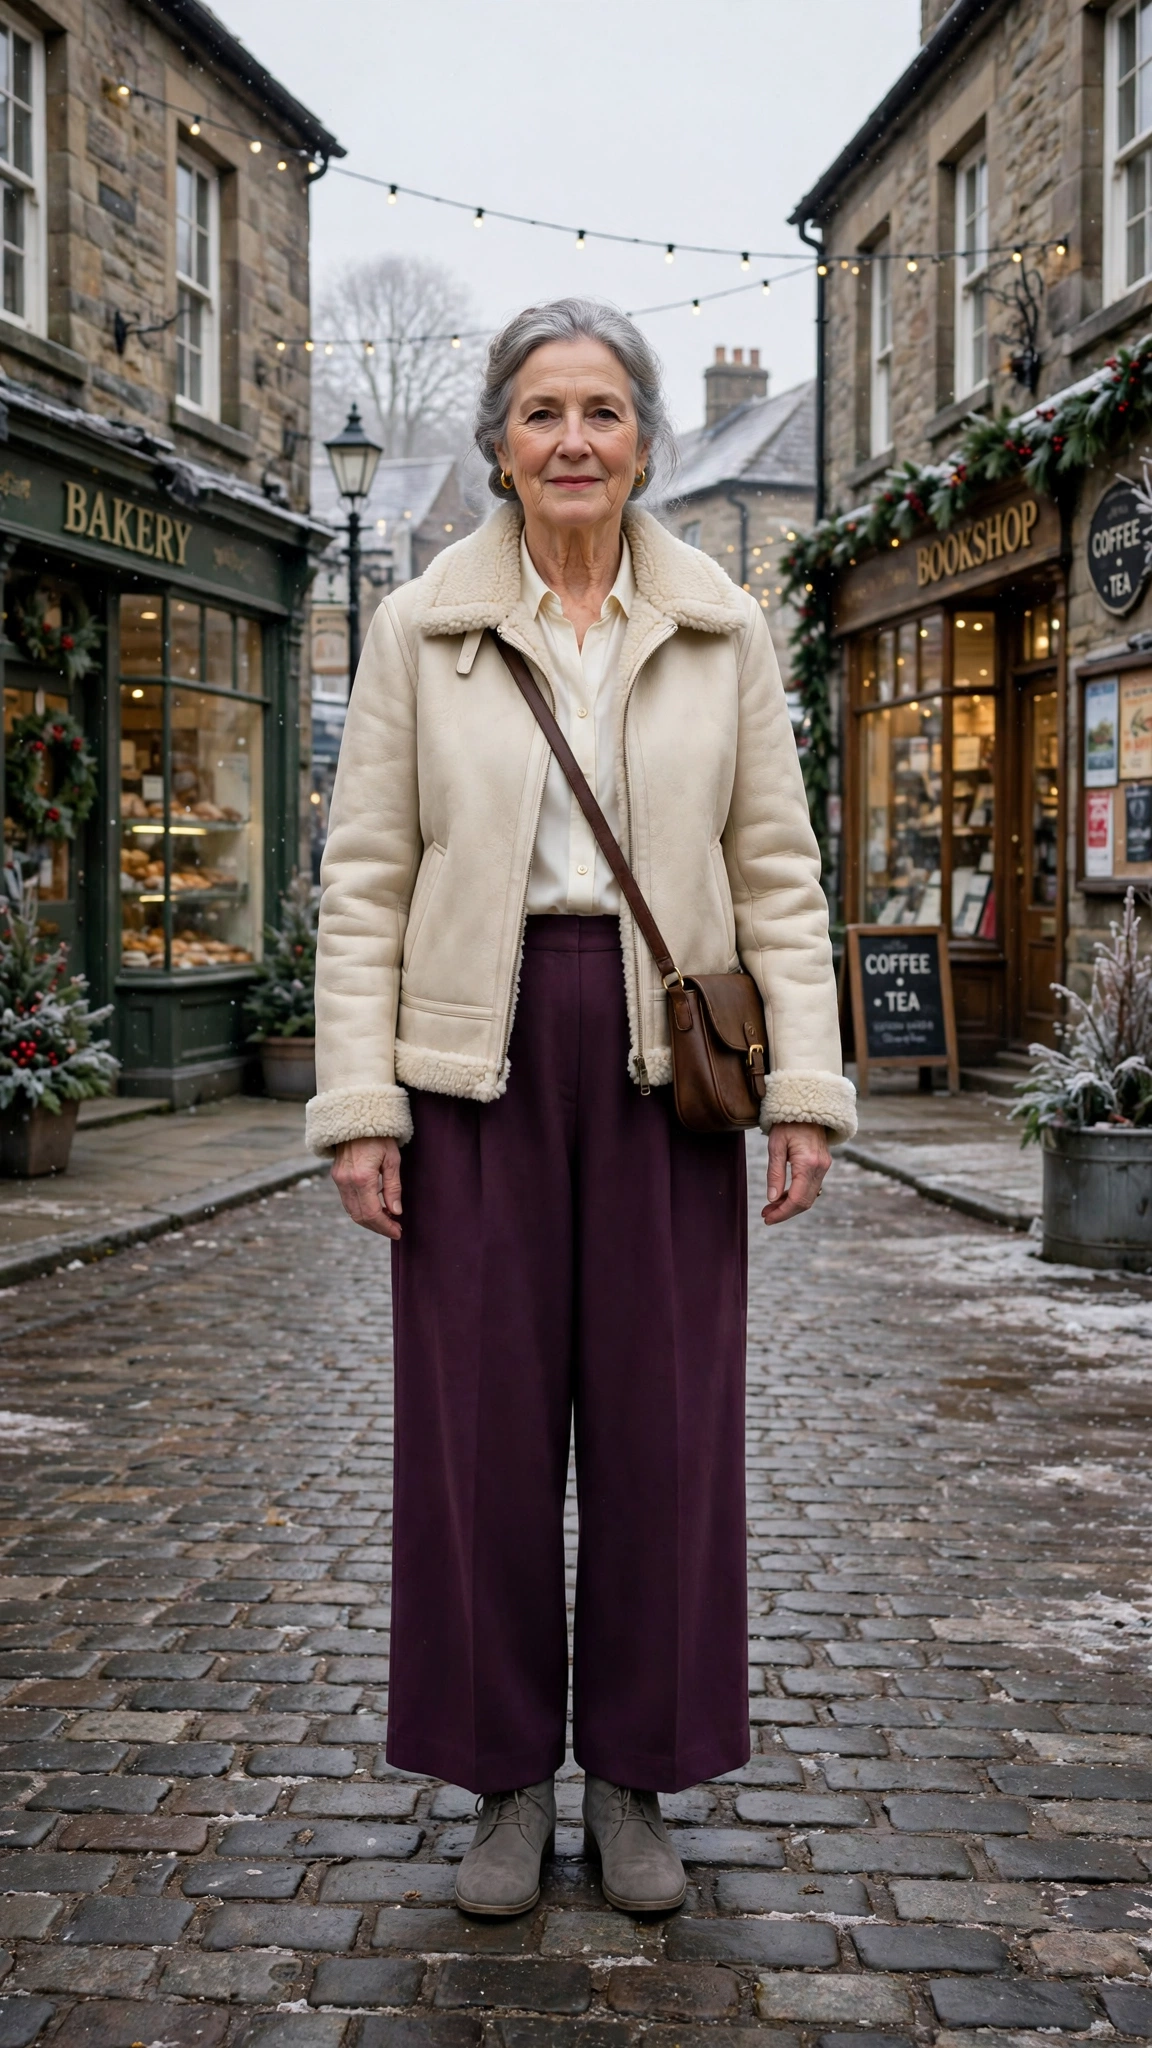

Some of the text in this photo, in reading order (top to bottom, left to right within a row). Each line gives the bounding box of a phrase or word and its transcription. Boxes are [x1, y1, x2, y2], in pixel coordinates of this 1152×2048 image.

[64, 480, 193, 567] BAKERY
[1091, 518, 1141, 559] COFFEE
[915, 500, 1038, 587] BOOKSHOP
[1109, 571, 1132, 598] TEA
[865, 953, 931, 975] COFFEE
[884, 991, 921, 1012] TEA
